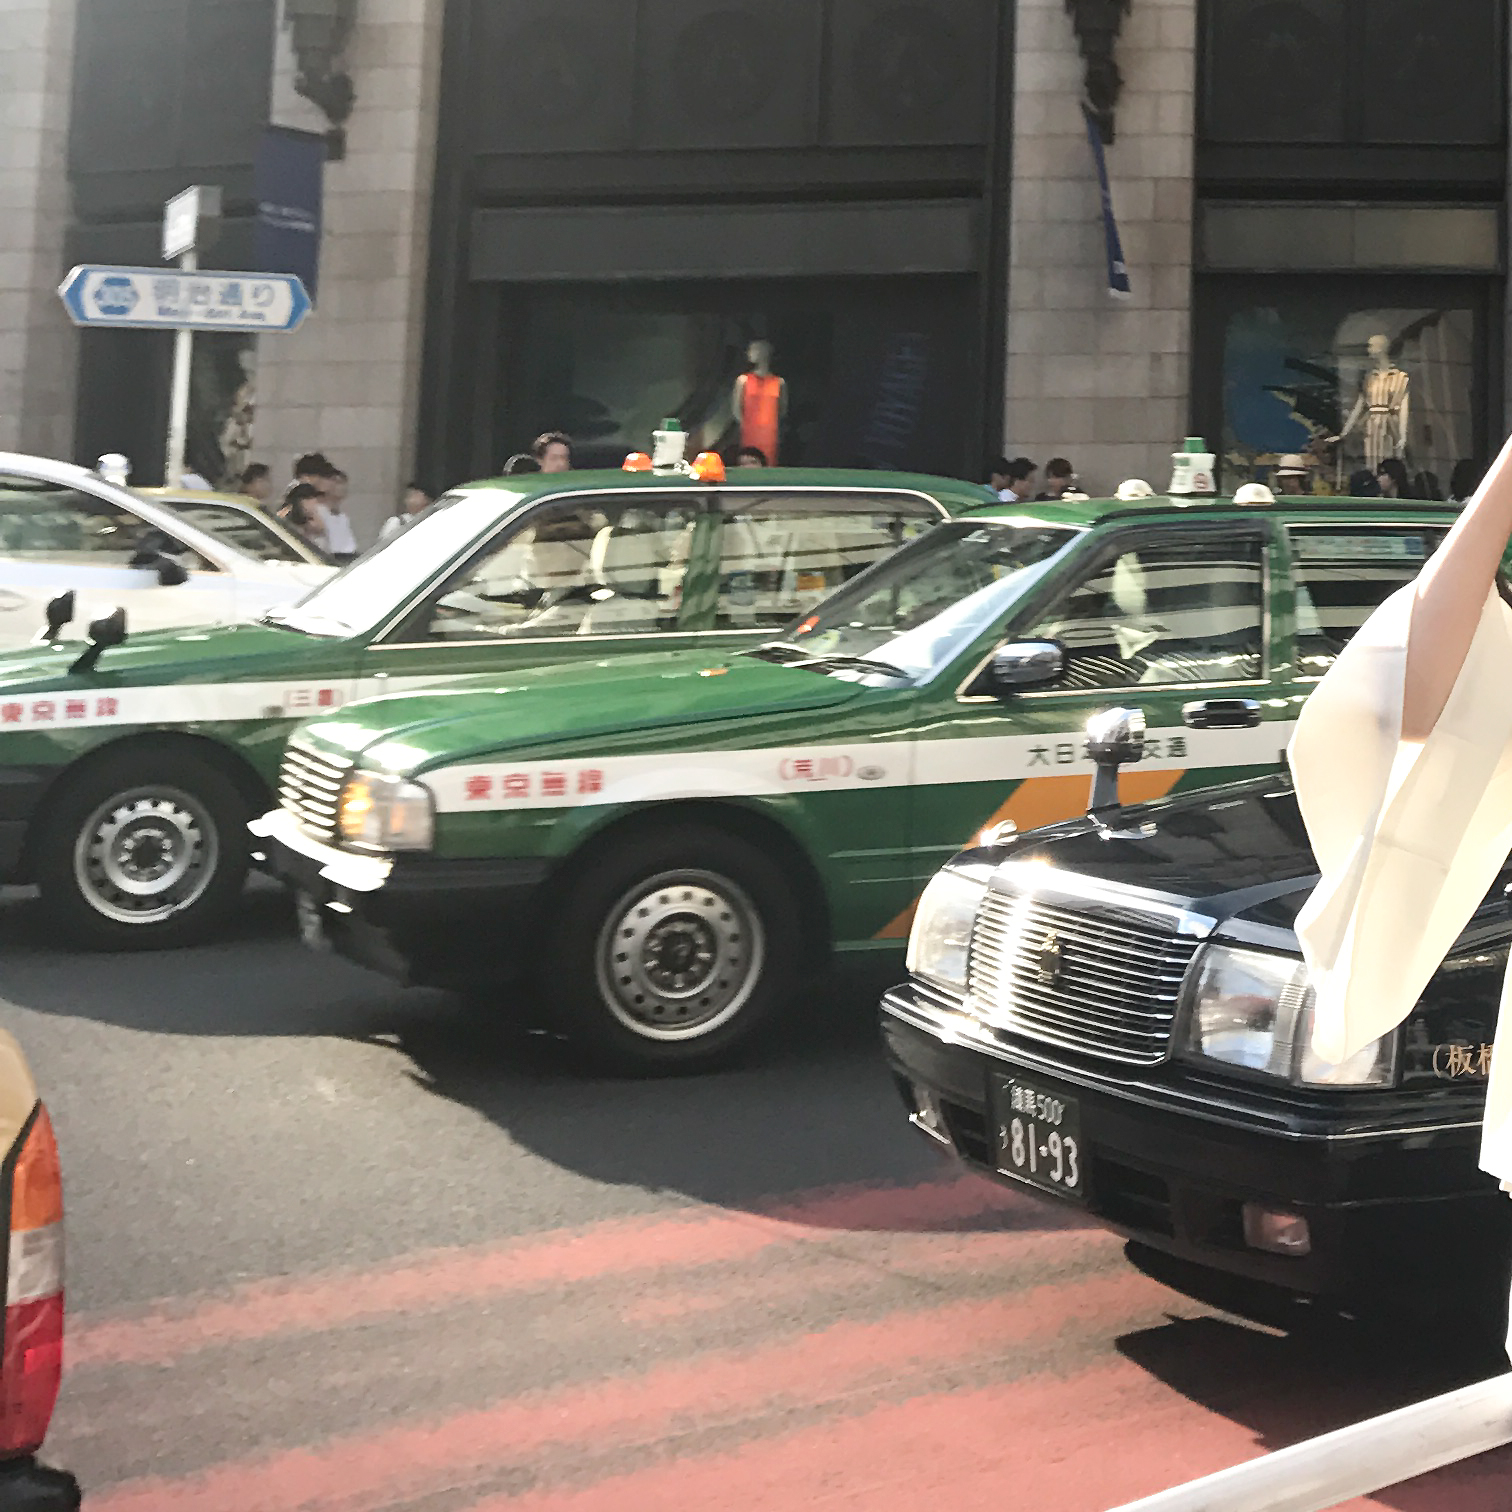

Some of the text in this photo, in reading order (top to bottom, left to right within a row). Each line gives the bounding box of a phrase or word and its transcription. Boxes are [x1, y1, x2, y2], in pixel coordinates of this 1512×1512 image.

[465, 768, 603, 801] 東京無線
[1010, 1117, 1079, 1188] 81-93
